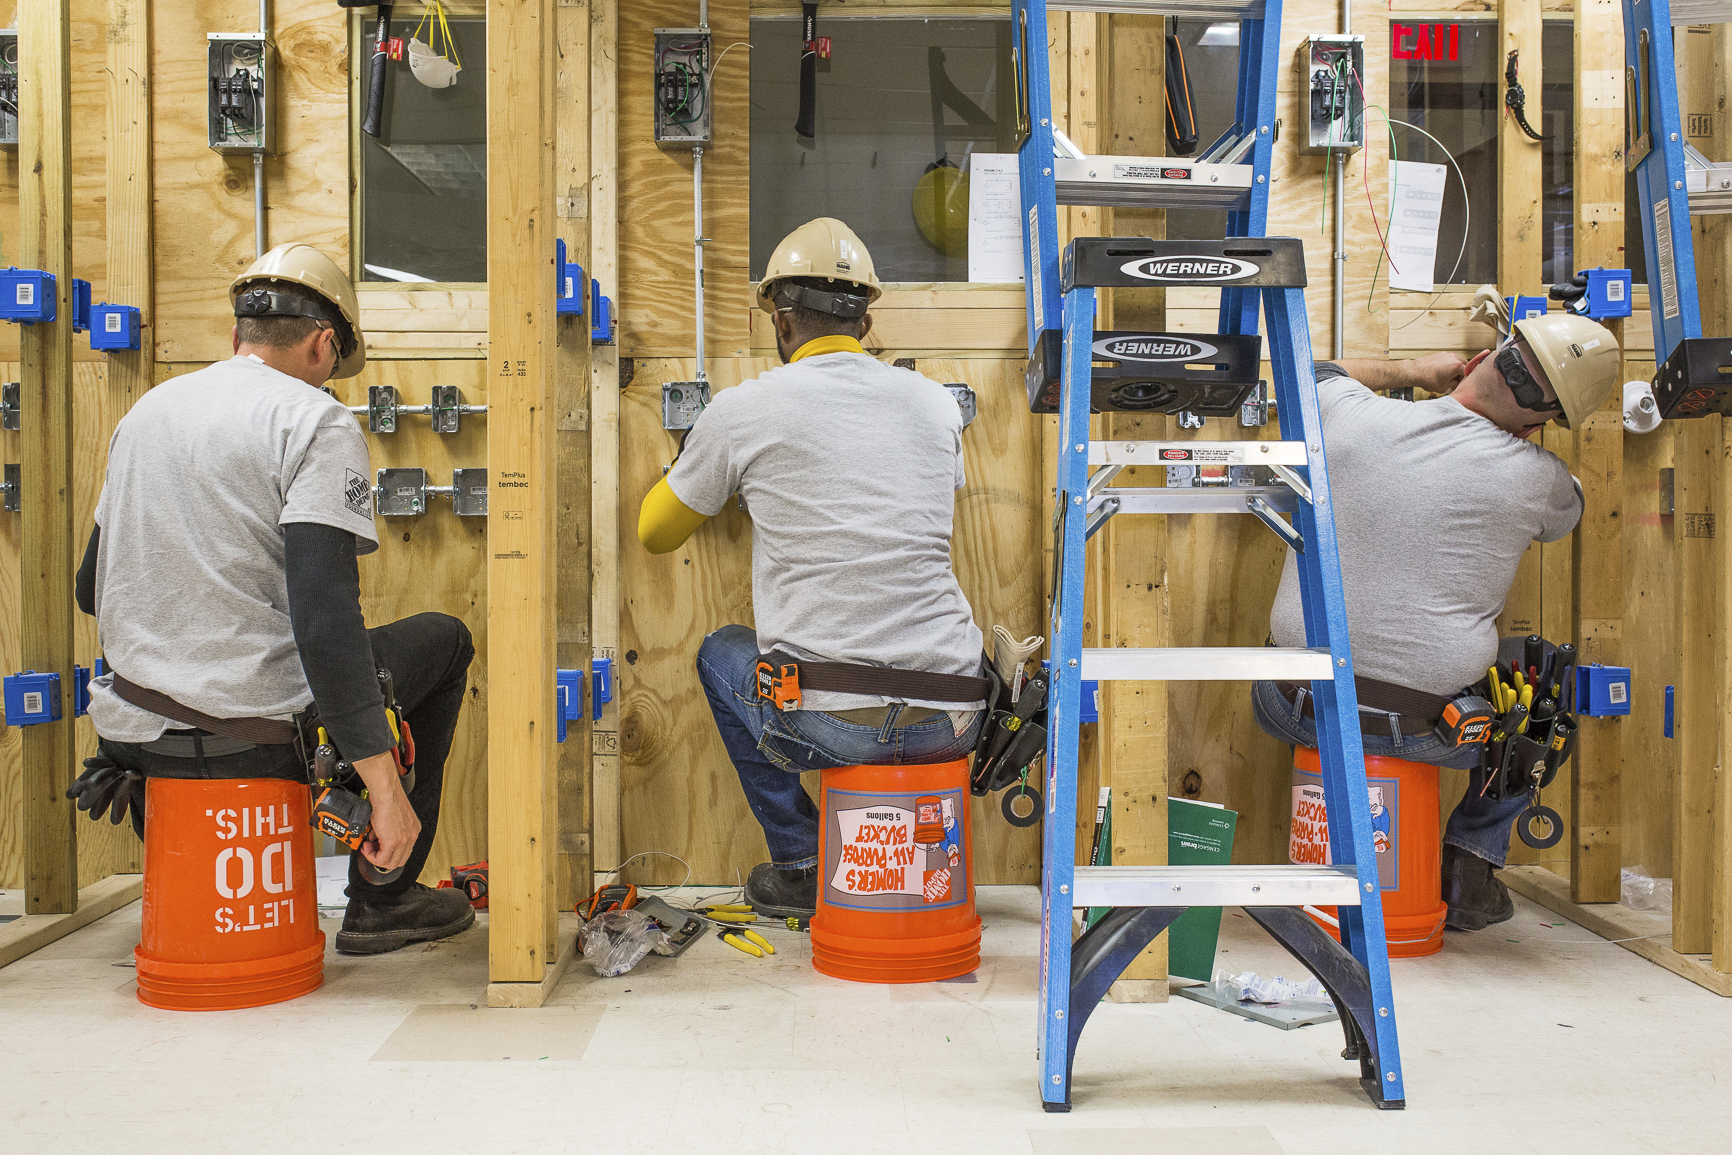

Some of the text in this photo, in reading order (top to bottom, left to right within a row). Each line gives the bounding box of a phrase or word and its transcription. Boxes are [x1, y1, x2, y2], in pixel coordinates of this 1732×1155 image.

[1149, 262, 1233, 275] WERNER
[1113, 342, 1192, 355] WERNER
[346, 480, 370, 502] HOME
[349, 476, 360, 487] THE
[1303, 790, 1320, 800] Gallons
[206, 804, 293, 840] THIS.
[866, 812, 893, 820] Gallons
[1297, 800, 1327, 822] BUCKET
[855, 824, 907, 846] BUCKET
[1181, 841, 1220, 852] CENGAGEbrain
[216, 840, 293, 899] DO
[846, 867, 905, 892] HOMER'S
[924, 869, 942, 892] DEPOT
[924, 868, 951, 902] HOME
[937, 884, 949, 899] THE
[214, 898, 294, 934] LET'S
